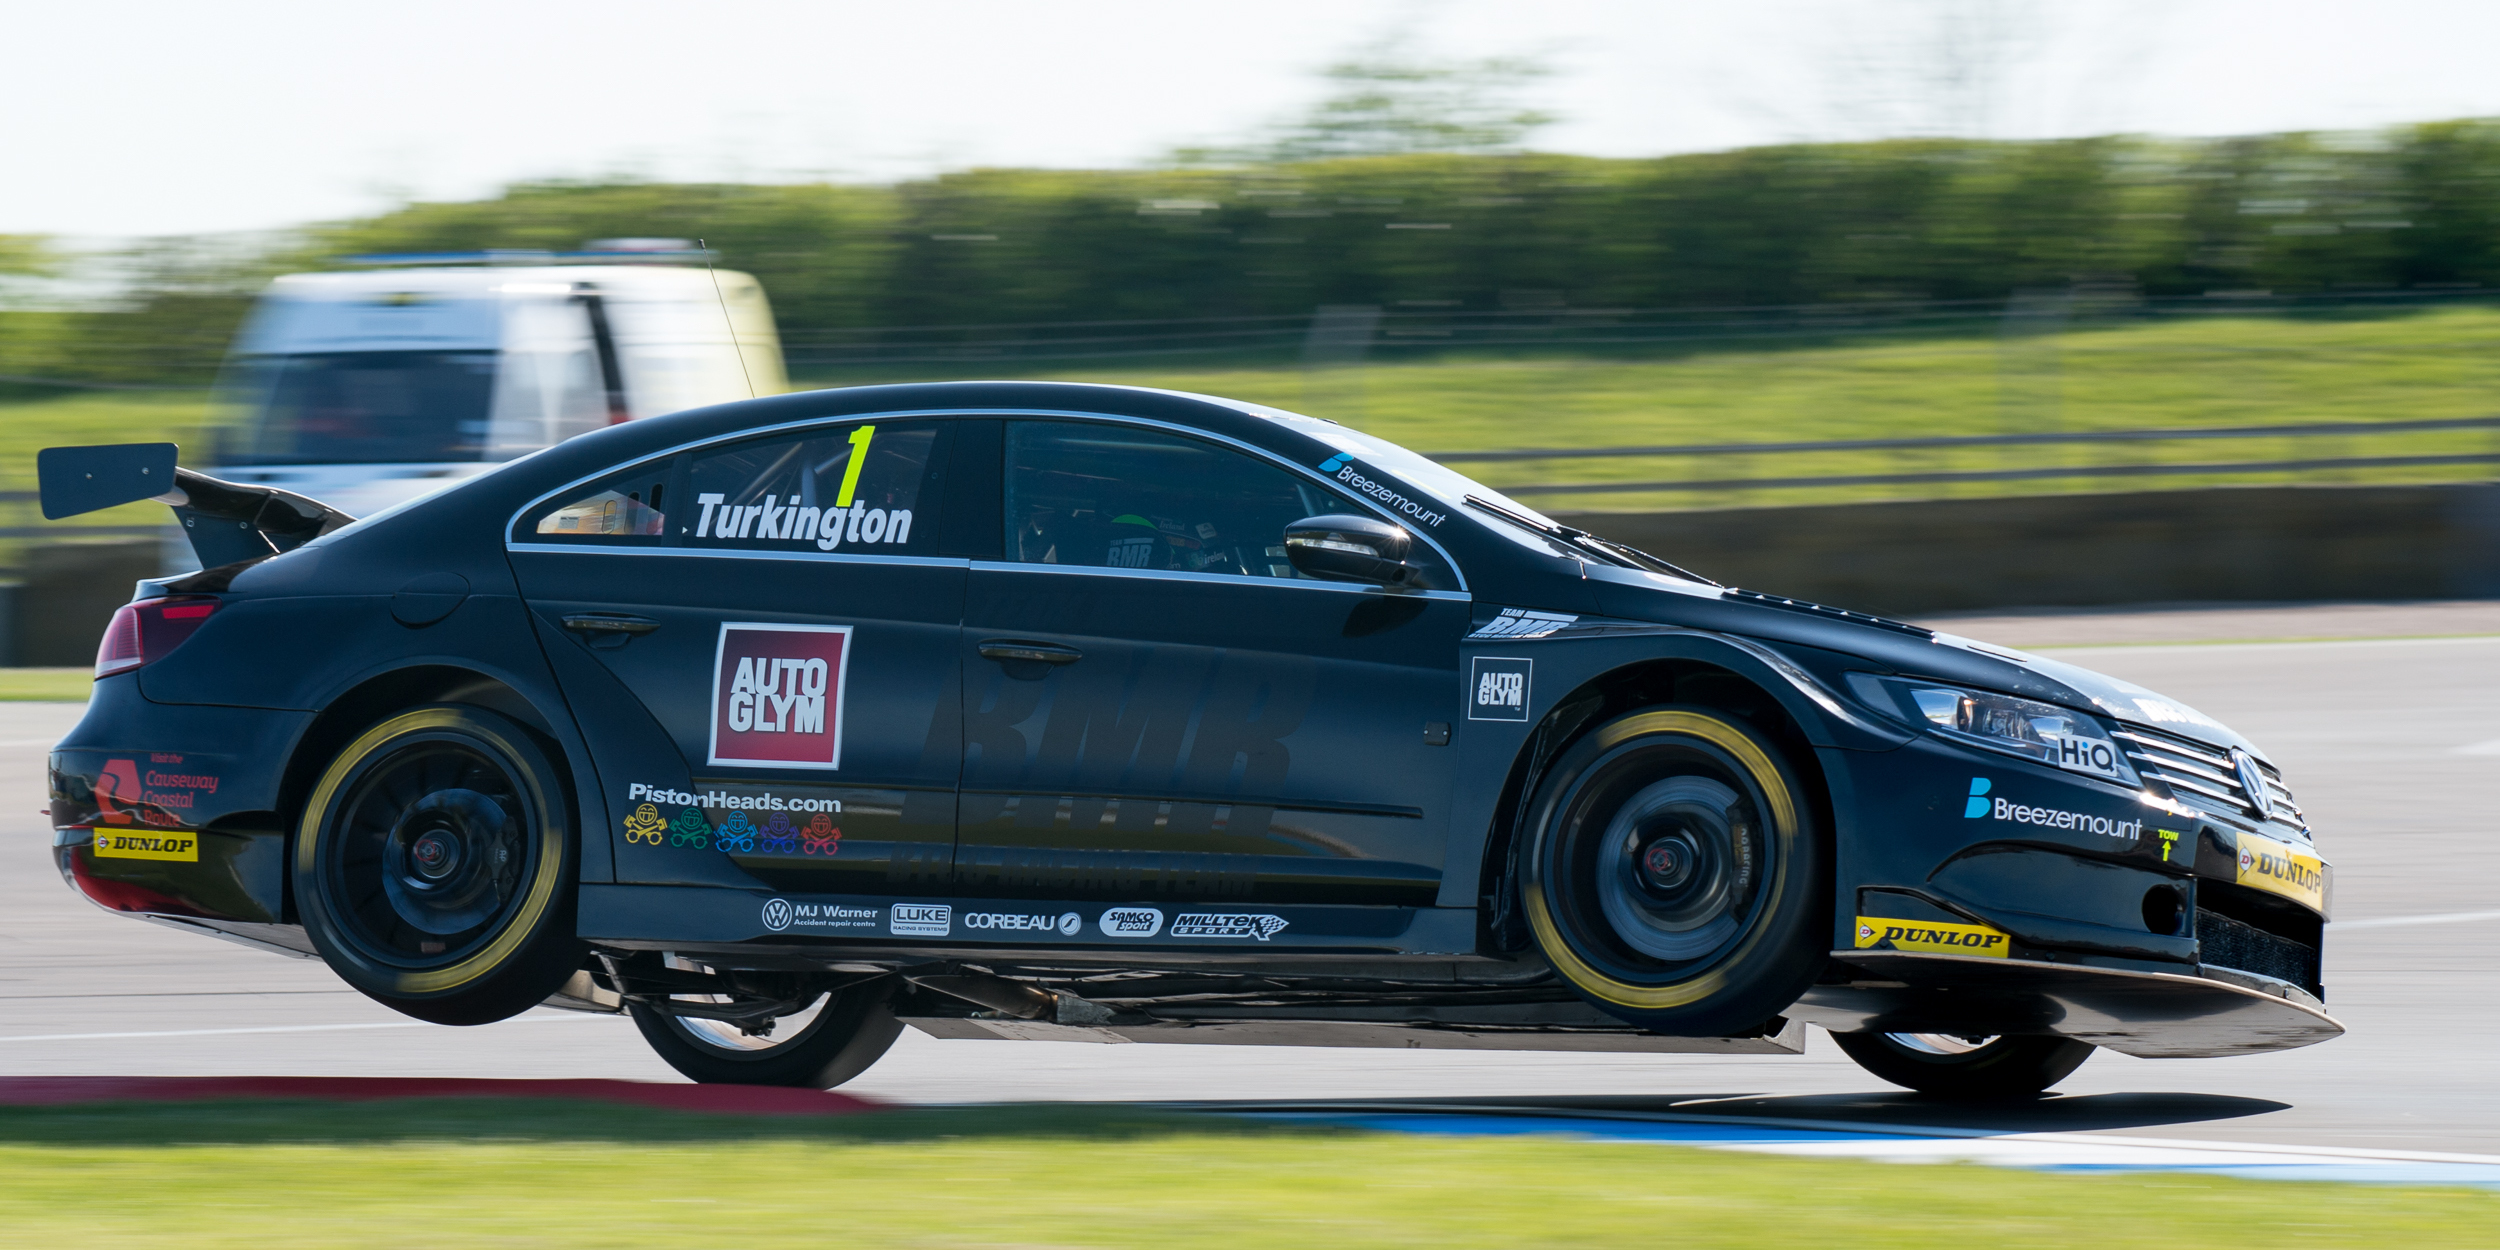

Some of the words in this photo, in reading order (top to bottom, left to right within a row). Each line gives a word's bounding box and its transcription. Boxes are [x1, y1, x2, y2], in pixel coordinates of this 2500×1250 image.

[835, 425, 876, 507] 1
[1336, 465, 1447, 528] Breezemount
[695, 493, 913, 551] Turkington
[1500, 607, 1526, 618] TEAM
[1474, 615, 1570, 635] BMR
[730, 656, 829, 699] AUTO
[1479, 672, 1524, 690] AUTO
[1477, 687, 1523, 706] GLYM
[728, 691, 826, 734] GLYM
[151, 753, 169, 763] Visit
[170, 754, 183, 764] the
[2060, 738, 2115, 773] HiQ
[145, 770, 219, 793] Causeway
[143, 790, 194, 808] Coastal
[628, 783, 842, 813] PistonHeads.com
[143, 809, 182, 827] Route
[1994, 797, 2143, 841] Breezemount
[113, 836, 194, 853] DUNLOP
[2157, 829, 2179, 841] TOW
[2257, 853, 2322, 894] DUNLOP
[794, 905, 818, 917] MJ
[823, 905, 878, 918] Warner
[896, 908, 947, 921] LUKE
[1108, 911, 1155, 923] SAMCO
[794, 919, 827, 927] Accident
[828, 920, 851, 928] repair
[963, 912, 1056, 931] CORBEAU
[1118, 921, 1151, 932] sport
[1884, 926, 2004, 948] DUNLOP
